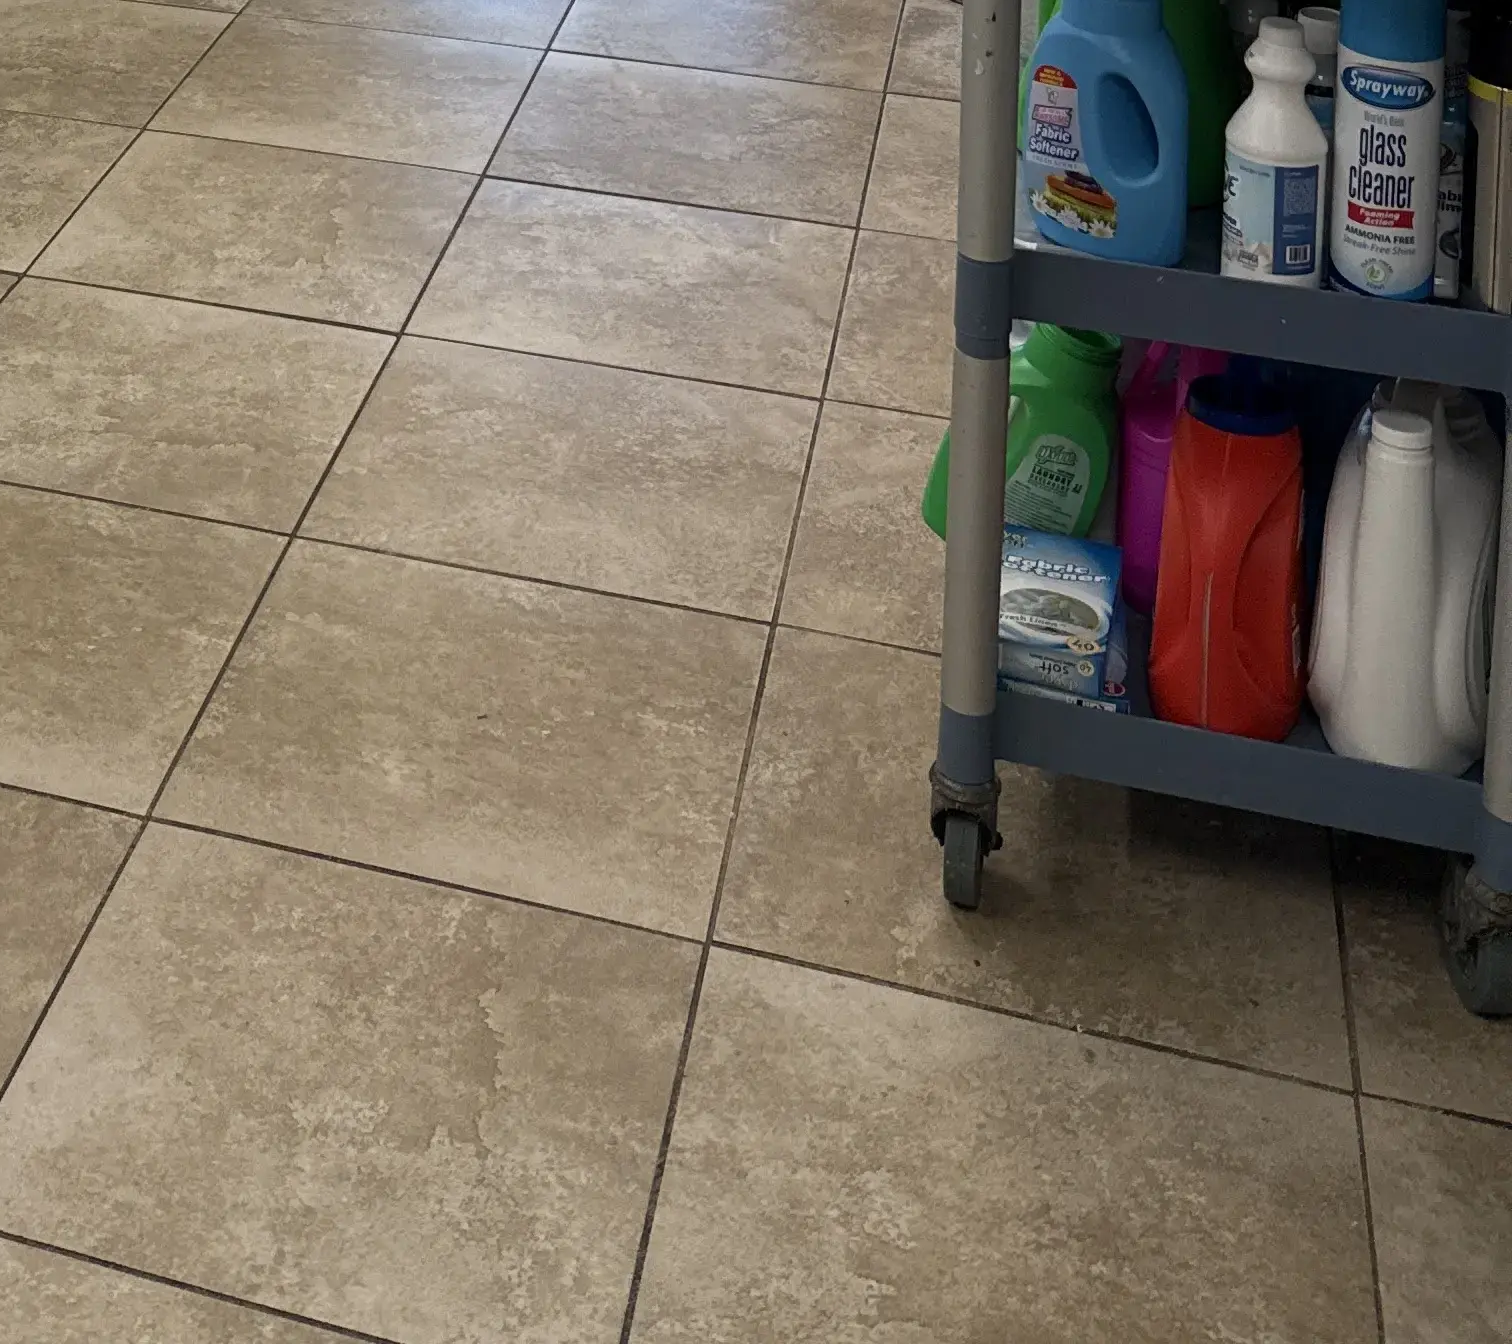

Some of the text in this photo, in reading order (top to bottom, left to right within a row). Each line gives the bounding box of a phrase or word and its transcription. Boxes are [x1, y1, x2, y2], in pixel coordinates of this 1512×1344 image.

[1349, 70, 1426, 101] Sprayway
[1035, 123, 1071, 143] Fabric
[1029, 137, 1079, 161] Softener
[1359, 124, 1407, 168] glass
[1348, 165, 1415, 208] cleaner
[1359, 208, 1400, 221] Foaming
[1364, 216, 1395, 226] Action
[1345, 224, 1415, 245] AMMONIA FREE
[1032, 466, 1073, 486] LAUNDRY
[1002, 561, 1106, 582] oftener
[1006, 555, 1090, 575] Fabric
[1039, 661, 1069, 675] soft
